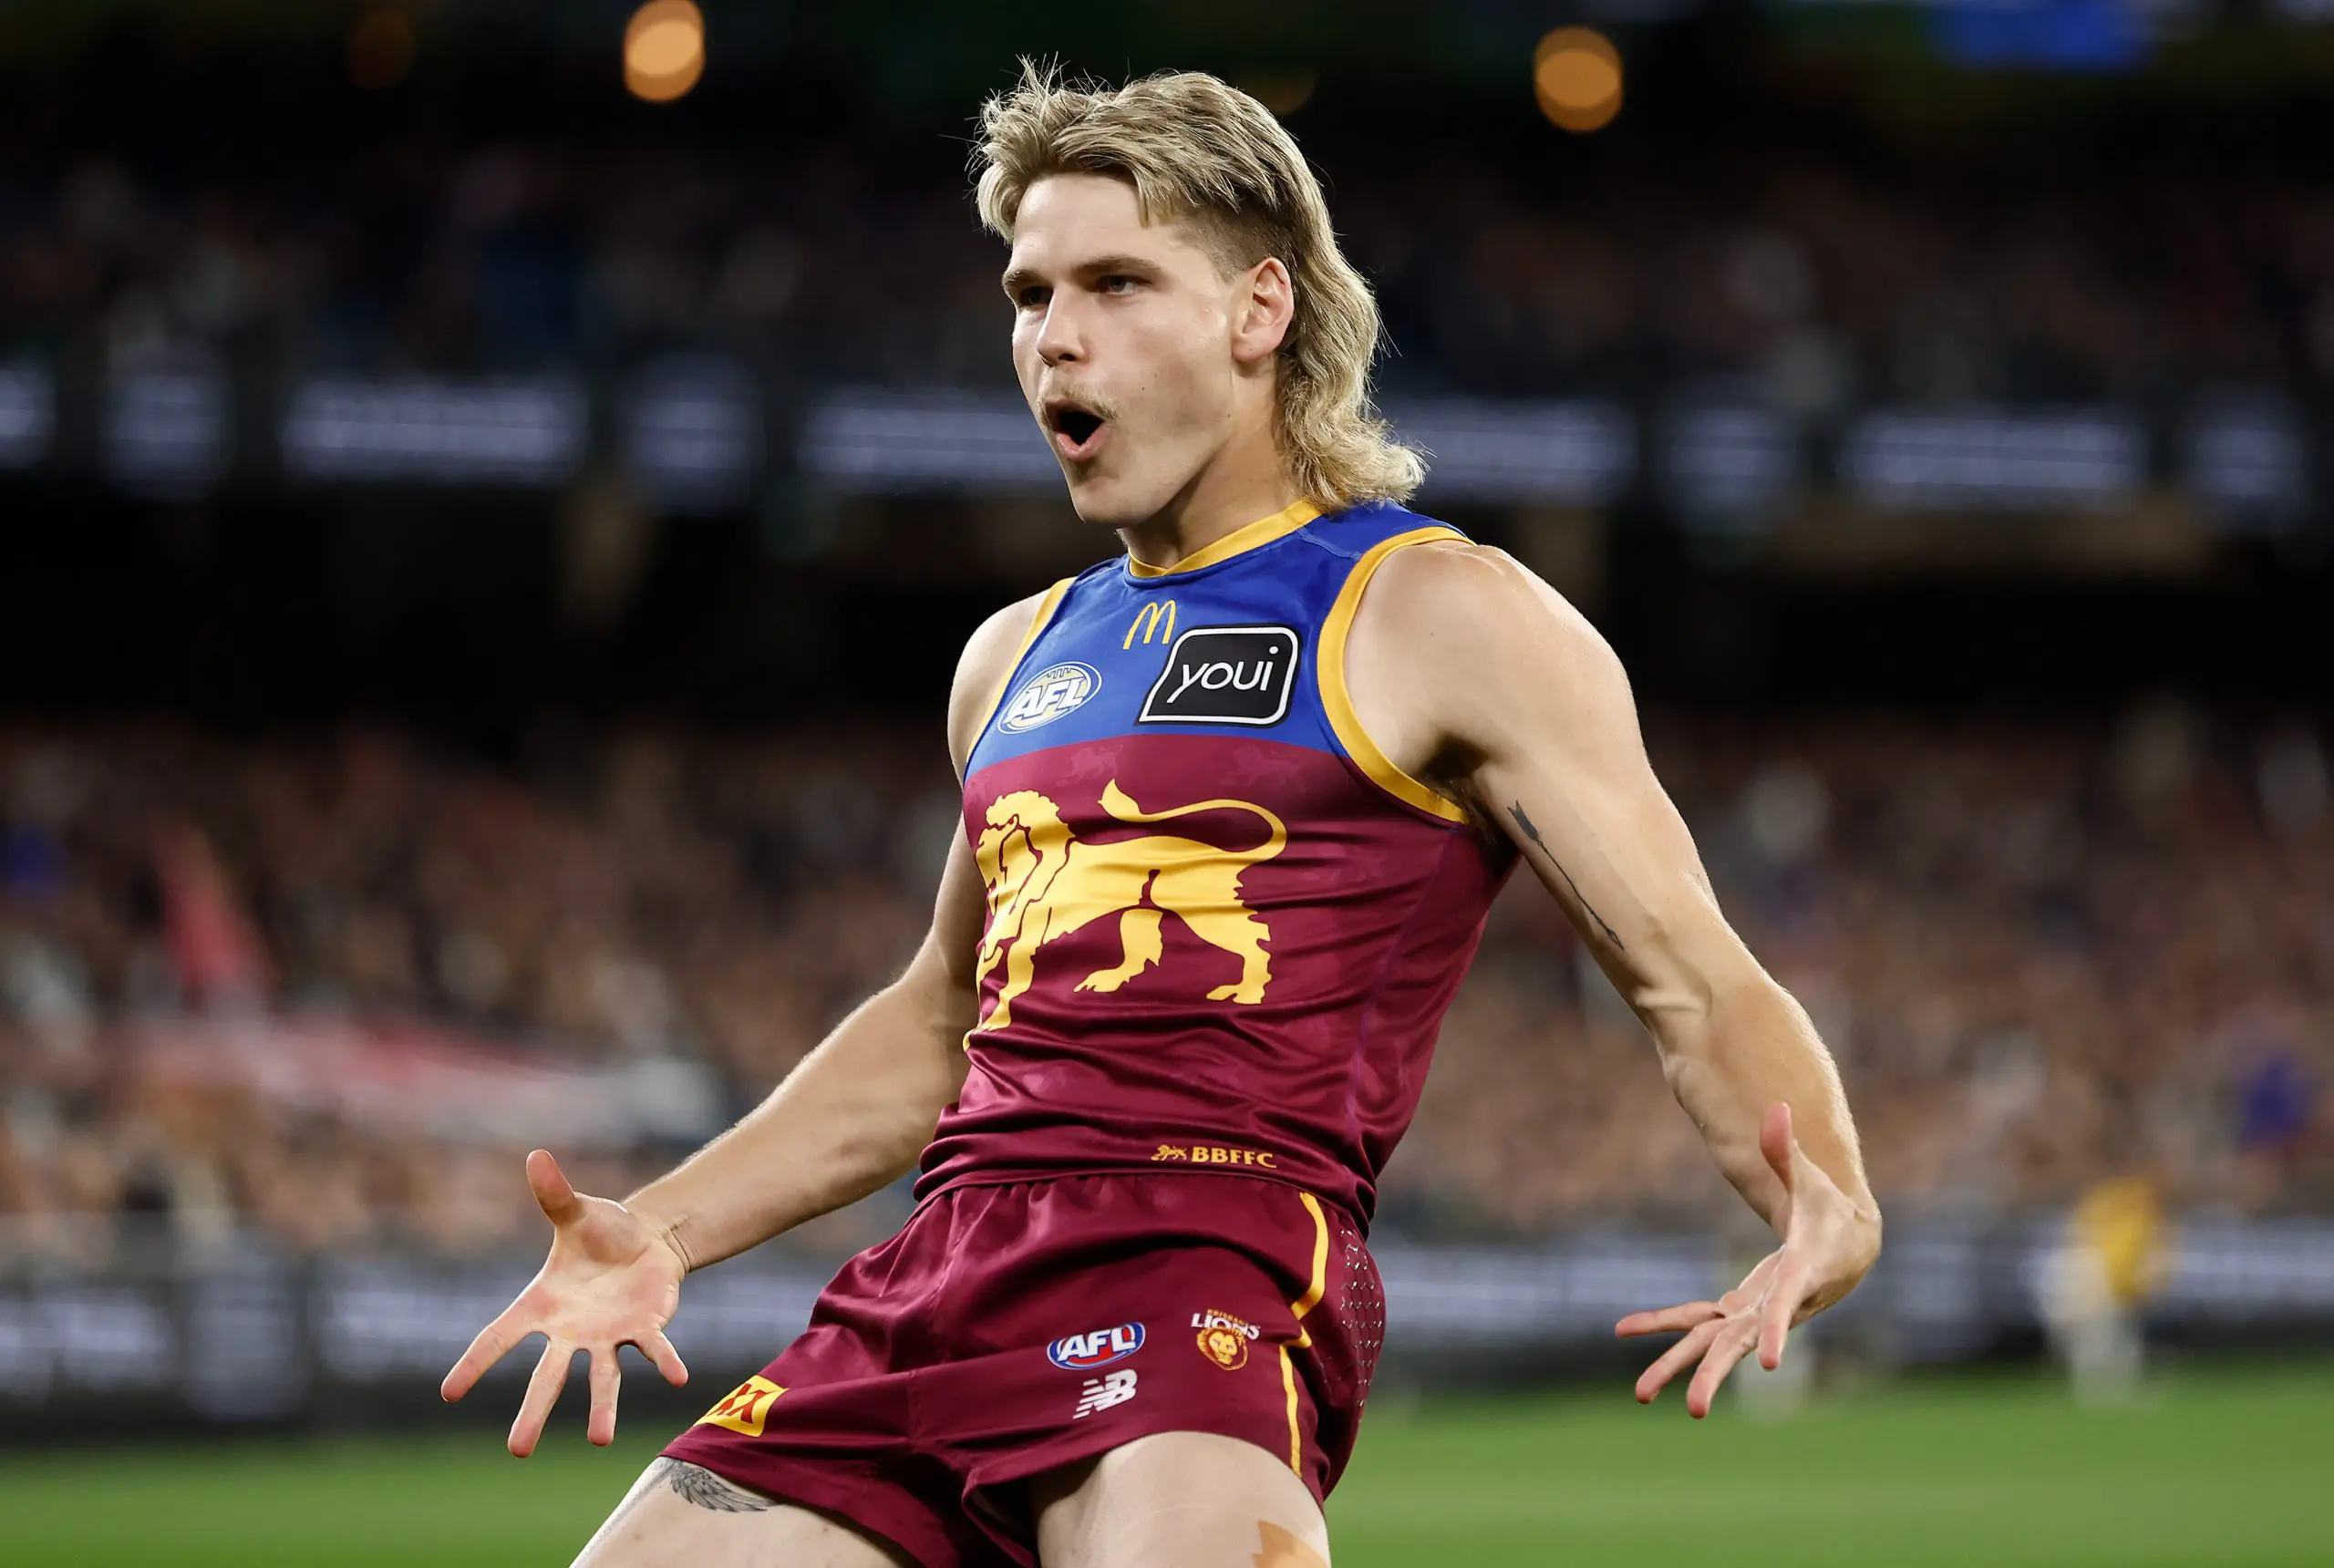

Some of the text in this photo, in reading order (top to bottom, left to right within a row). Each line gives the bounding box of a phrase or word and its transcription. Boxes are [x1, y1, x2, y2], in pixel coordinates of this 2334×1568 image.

[1167, 645, 1279, 704] youi
[1003, 676, 1087, 724] AFL
[1192, 1146, 1277, 1169] BBFFC
[1057, 1325, 1138, 1362] AFL
[1191, 1313, 1261, 1340] LIONS
